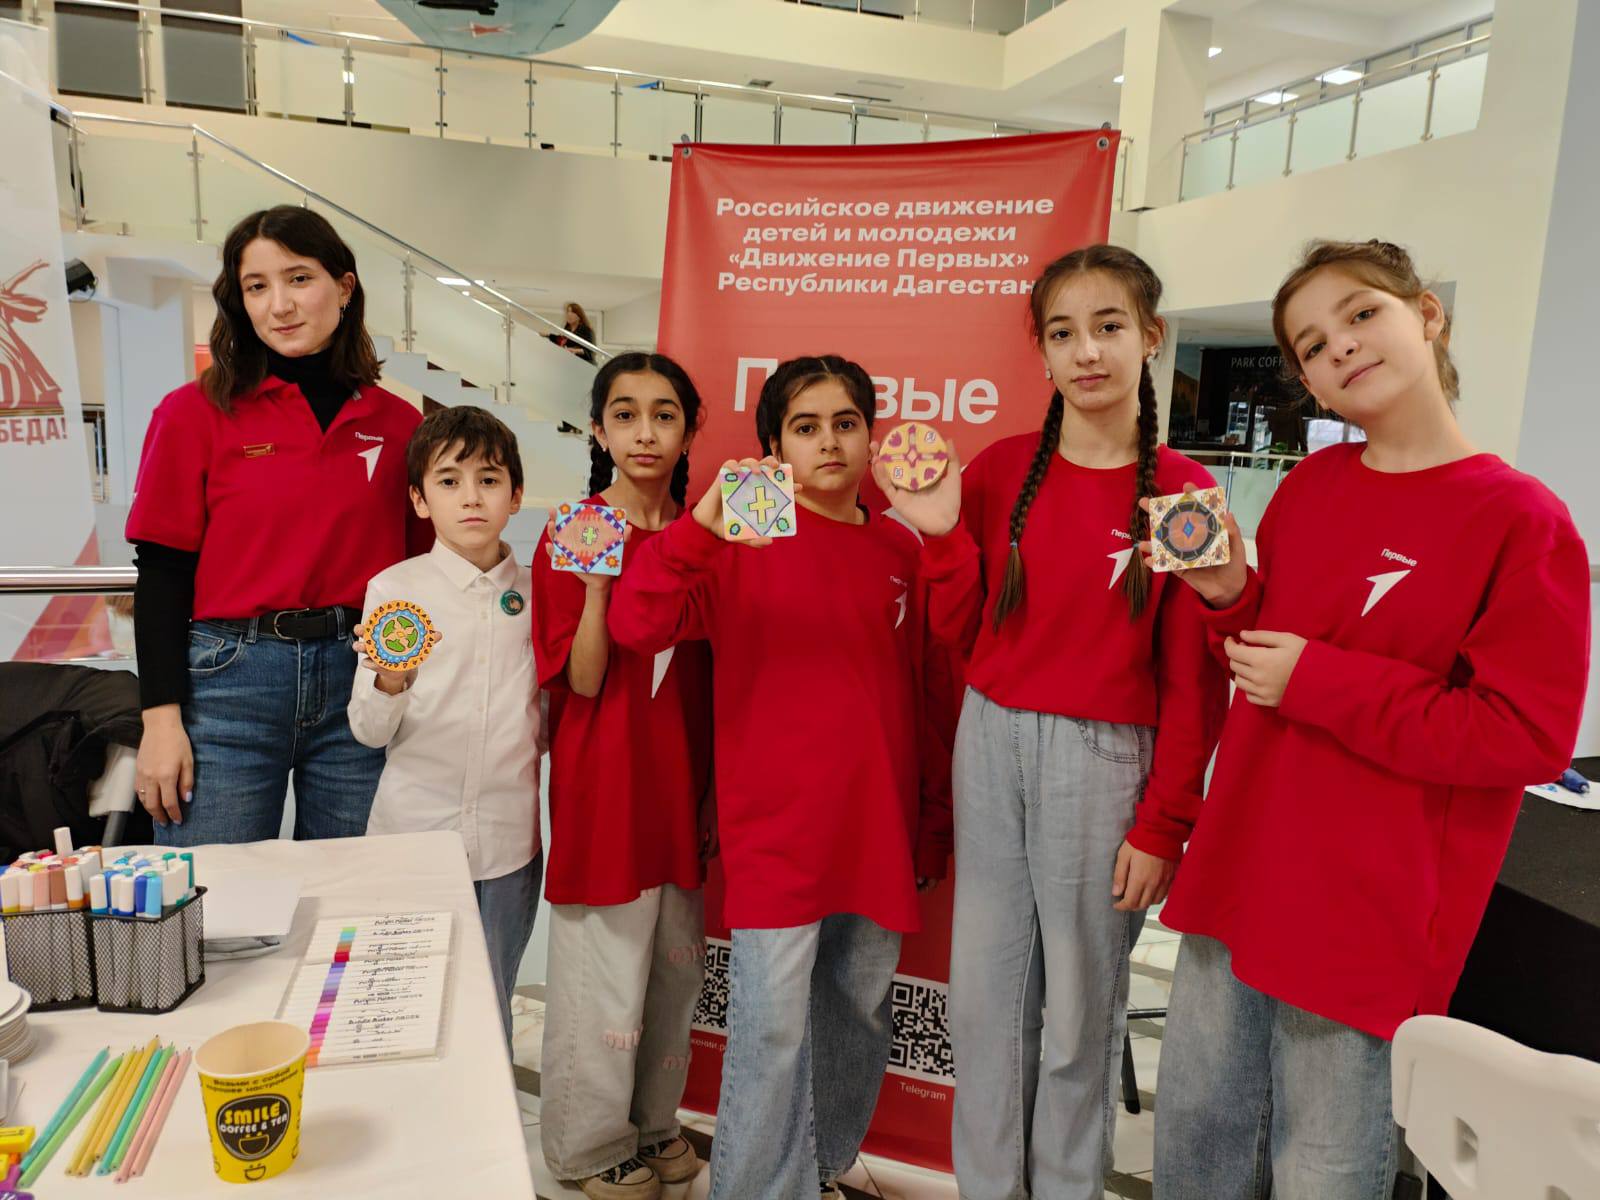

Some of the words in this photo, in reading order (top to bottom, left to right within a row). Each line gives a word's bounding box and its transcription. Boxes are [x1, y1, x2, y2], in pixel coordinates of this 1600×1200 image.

[717, 197, 890, 217] Российское
[895, 198, 1054, 219] движение
[743, 222, 827, 244] детей
[833, 227, 851, 242] и
[858, 226, 1016, 244] молодежи
[729, 248, 890, 269] «Движение
[897, 248, 1029, 272] Первых»
[718, 272, 887, 296] Республики
[1231, 356, 1255, 368] PARK
[734, 357, 999, 424] Пвые
[1381, 548, 1418, 567] Первые
[899, 1082, 946, 1101] Telegram
[220, 1124, 257, 1134] COFFEE
[271, 1113, 288, 1127] TEA
[224, 1100, 281, 1125] SMILE
